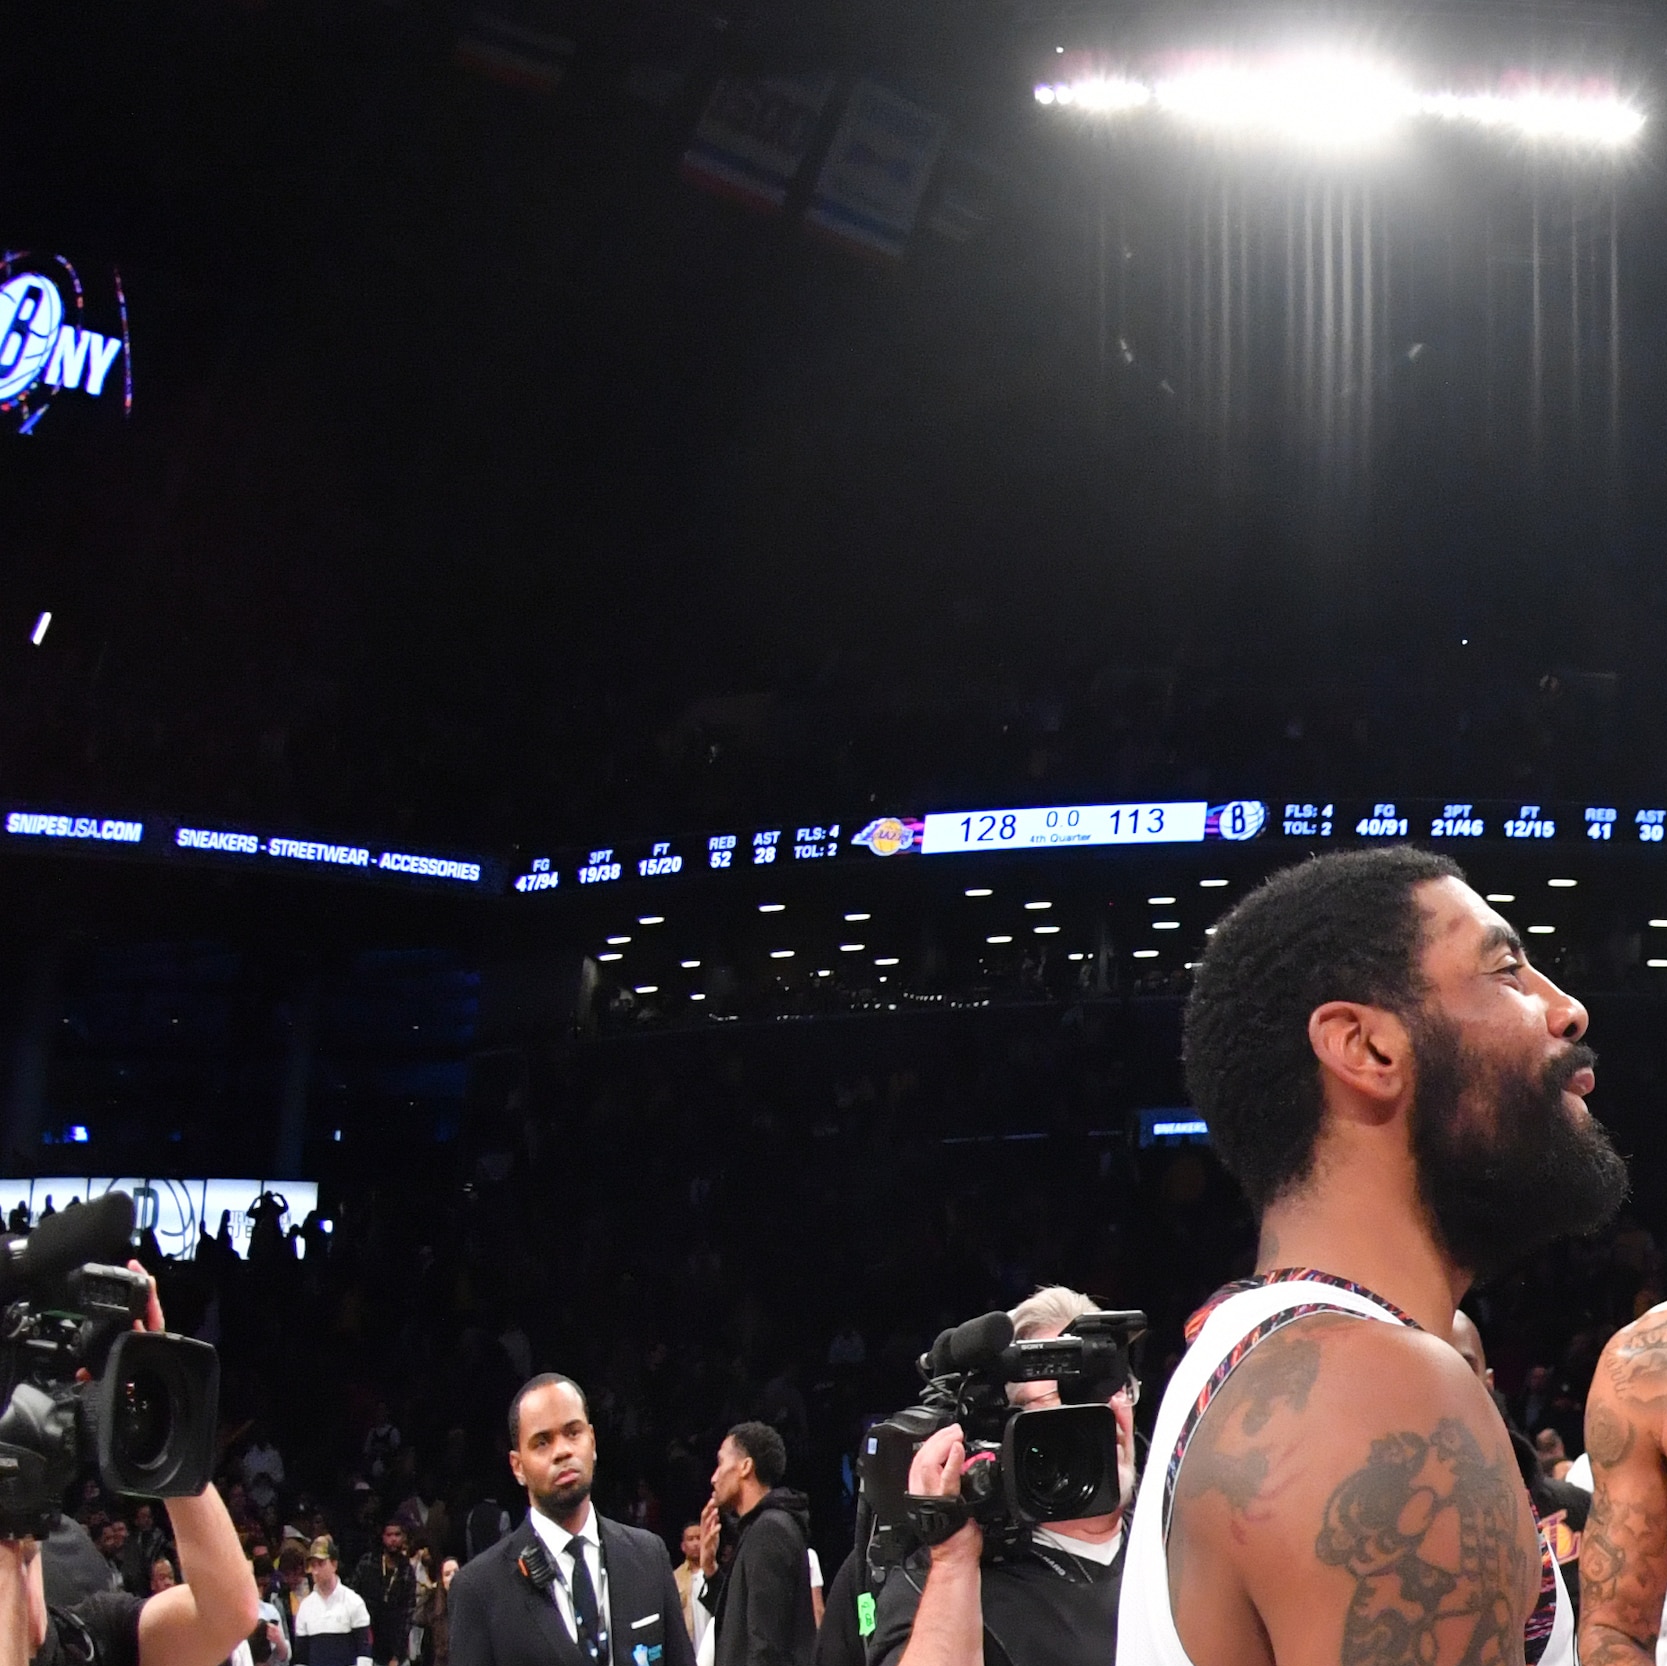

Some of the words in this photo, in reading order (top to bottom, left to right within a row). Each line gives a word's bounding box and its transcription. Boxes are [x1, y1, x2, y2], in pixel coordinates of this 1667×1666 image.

[44, 325, 121, 396] NY
[1046, 810, 1080, 828] 0.0
[1284, 803, 1318, 819] FLS:
[1321, 803, 1334, 818] 4
[1373, 803, 1396, 818] FG
[1443, 804, 1473, 819] 3PT
[1520, 805, 1541, 820] FT
[1584, 807, 1617, 823] REB
[1634, 809, 1667, 825] AST
[5, 812, 143, 843] SNIPESUSA.COM
[959, 814, 1017, 843] 128
[1109, 808, 1165, 835] 113
[1282, 820, 1317, 835] TOL:
[1320, 821, 1333, 836] 2
[1355, 818, 1408, 836] 40/91
[1430, 818, 1484, 837] 21/46
[1503, 819, 1556, 839] 12/15
[752, 830, 782, 847] AST
[796, 826, 827, 842] FLS:
[828, 824, 840, 838] 4
[1050, 832, 1091, 843] Quarter
[1587, 822, 1612, 840] 41
[1639, 823, 1665, 842] 30
[652, 842, 671, 857] FT
[708, 835, 737, 851] REB
[793, 844, 825, 859] TOL:
[827, 842, 838, 857] 2
[175, 827, 259, 854] SNEAKERS
[269, 836, 369, 867] STREETWEAR
[379, 854, 480, 881] ACCESSORIES
[588, 849, 614, 865] 3PT
[709, 850, 732, 869] 52
[753, 845, 777, 865] 28
[532, 857, 550, 873] FG
[577, 862, 622, 884] 19/38
[638, 855, 683, 877] 15/20
[514, 871, 559, 893] 47/94
